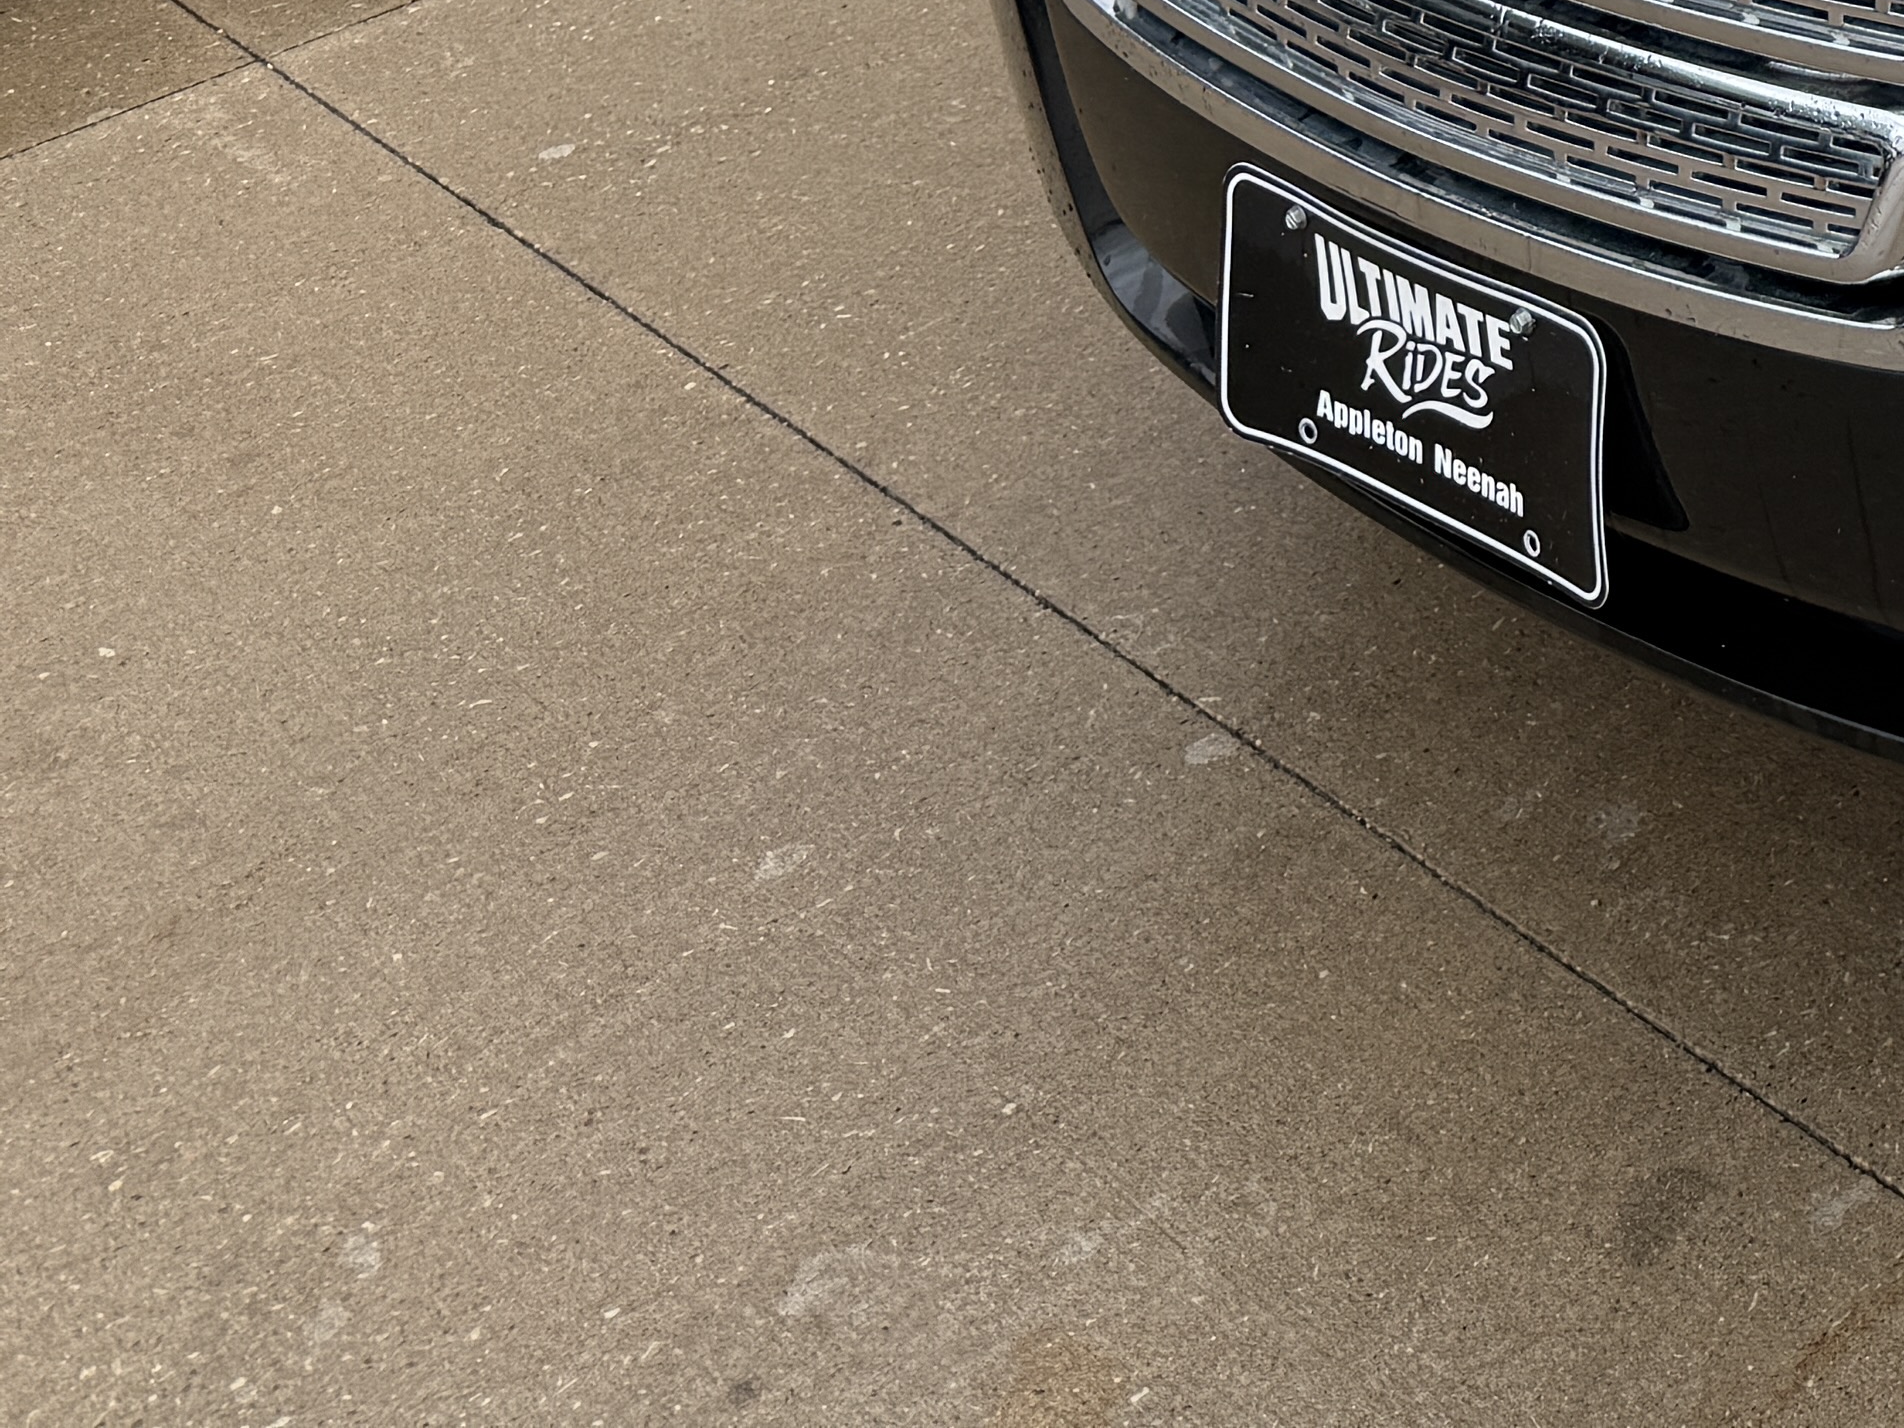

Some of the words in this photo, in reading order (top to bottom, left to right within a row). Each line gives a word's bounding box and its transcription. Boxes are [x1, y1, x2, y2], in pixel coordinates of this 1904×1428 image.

[1313, 232, 1514, 371] ULTIMATE
[1316, 389, 1424, 465] Appleton
[1433, 442, 1526, 519] Neenah
